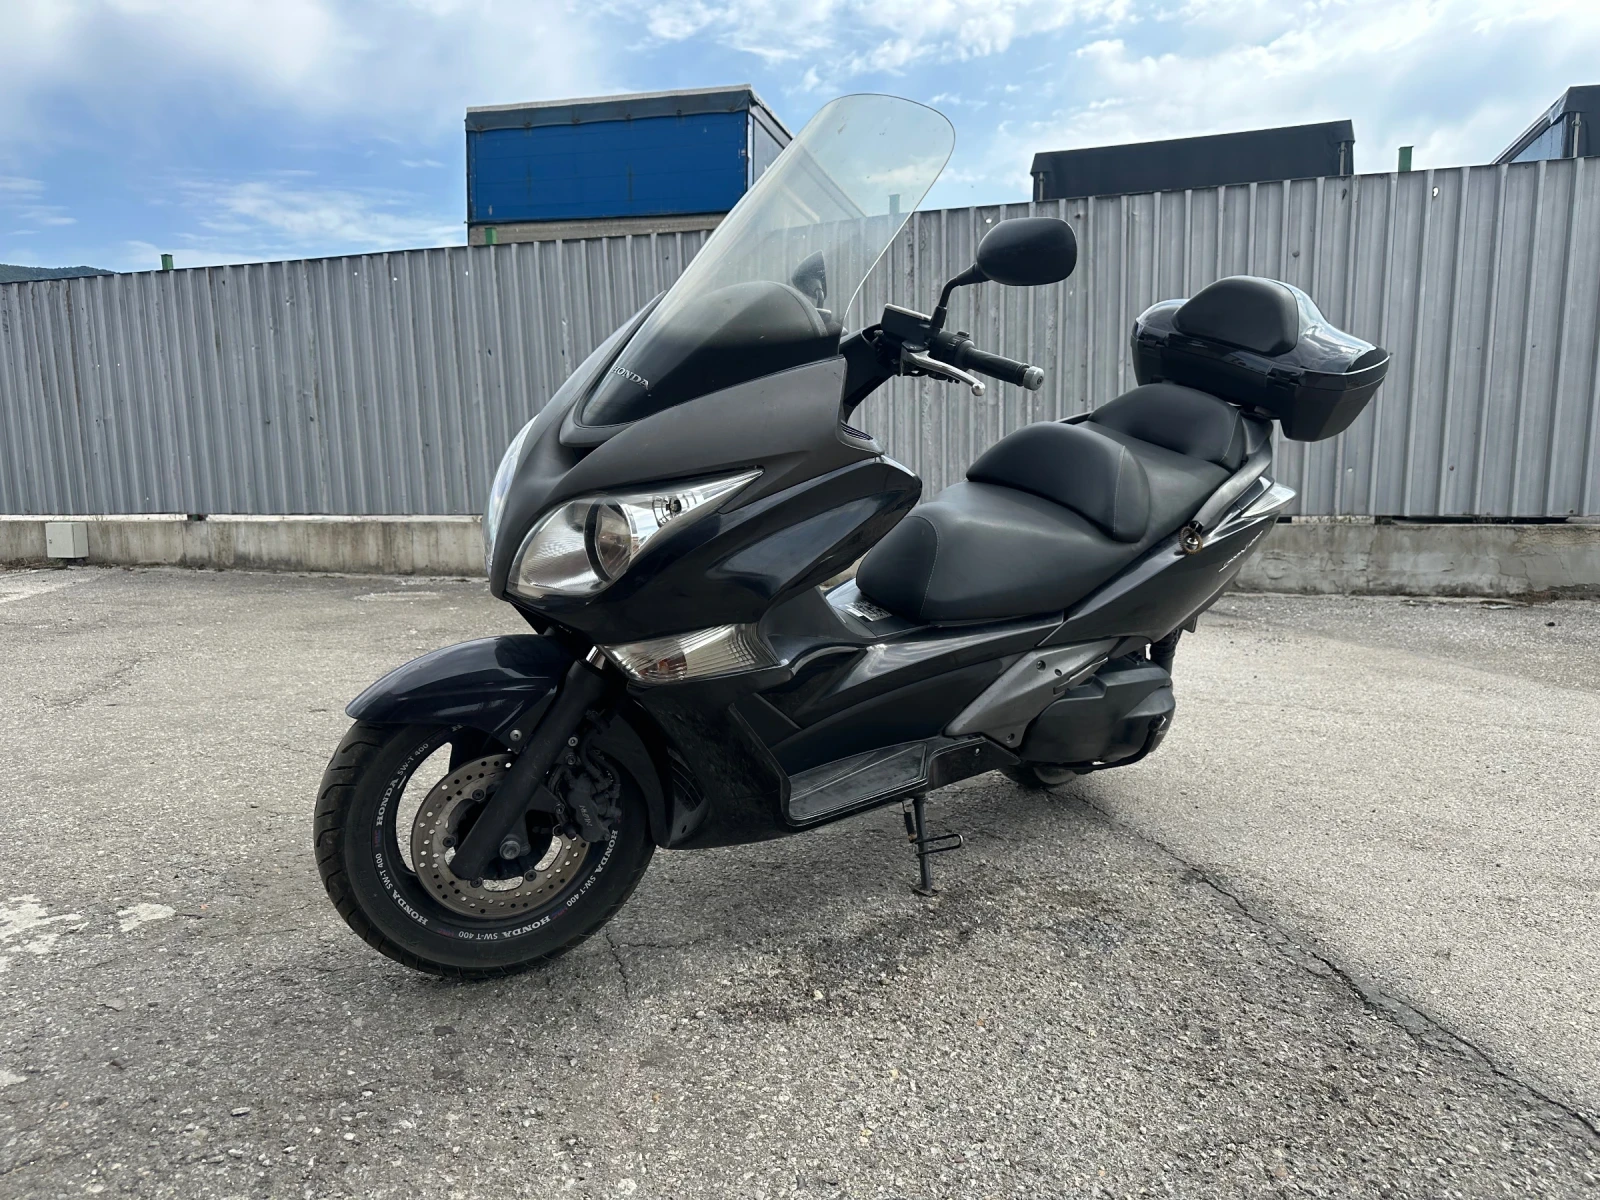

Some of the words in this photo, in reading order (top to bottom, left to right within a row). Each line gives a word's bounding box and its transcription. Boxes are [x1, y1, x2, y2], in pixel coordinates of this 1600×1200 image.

[611, 365, 649, 391] HONDA
[376, 778, 399, 826] HONDA
[397, 756, 414, 775] SW-T
[415, 743, 429, 756] 400
[375, 853, 384, 868] 400
[594, 829, 618, 874] HONDA
[380, 869, 393, 890] SW-T
[580, 875, 596, 895] SW-T
[392, 889, 428, 926] HONDA
[566, 893, 580, 907] 400
[458, 931, 474, 939] 400
[476, 932, 498, 940] SW-T
[501, 915, 551, 938] HONDA
